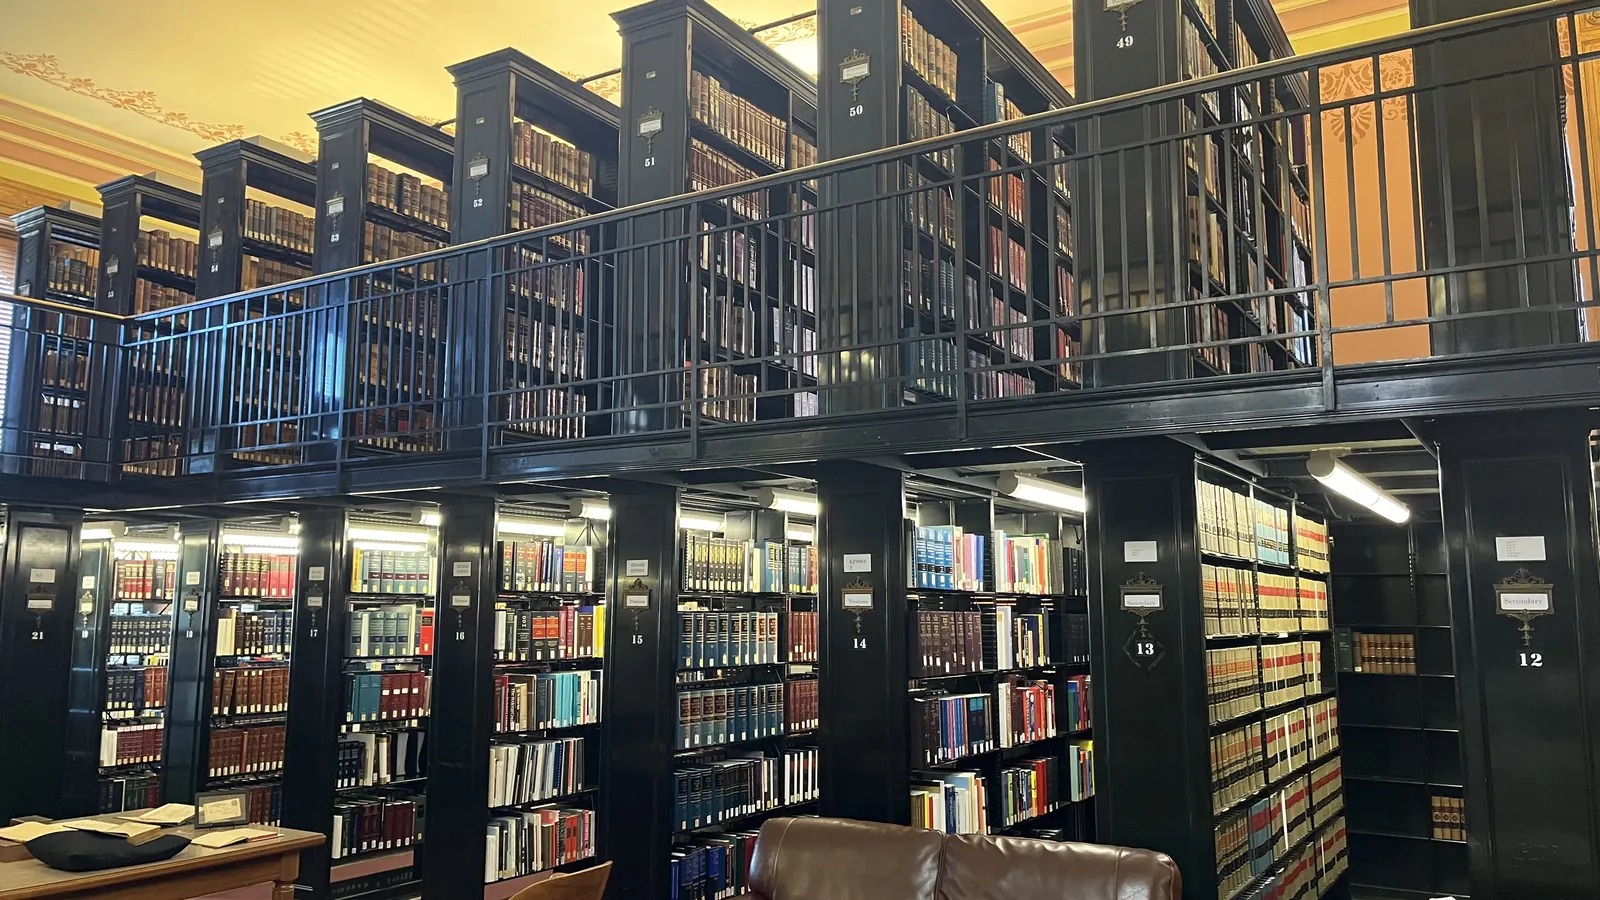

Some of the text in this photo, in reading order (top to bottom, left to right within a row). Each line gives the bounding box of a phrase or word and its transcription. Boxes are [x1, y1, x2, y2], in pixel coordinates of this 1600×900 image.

[1116, 35, 1134, 48] 49
[849, 105, 863, 117] 50
[644, 157, 655, 167] 51
[473, 198, 483, 208] 52
[330, 233, 340, 243] 53
[1504, 597, 1543, 606] Secondary
[31, 631, 44, 640] 21
[186, 630, 194, 638] 18
[310, 629, 318, 637] 17
[455, 631, 465, 640] 16
[632, 635, 643, 645] 15
[853, 638, 867, 649] 14
[1137, 643, 1155, 655] 13
[1519, 653, 1543, 667] 12
